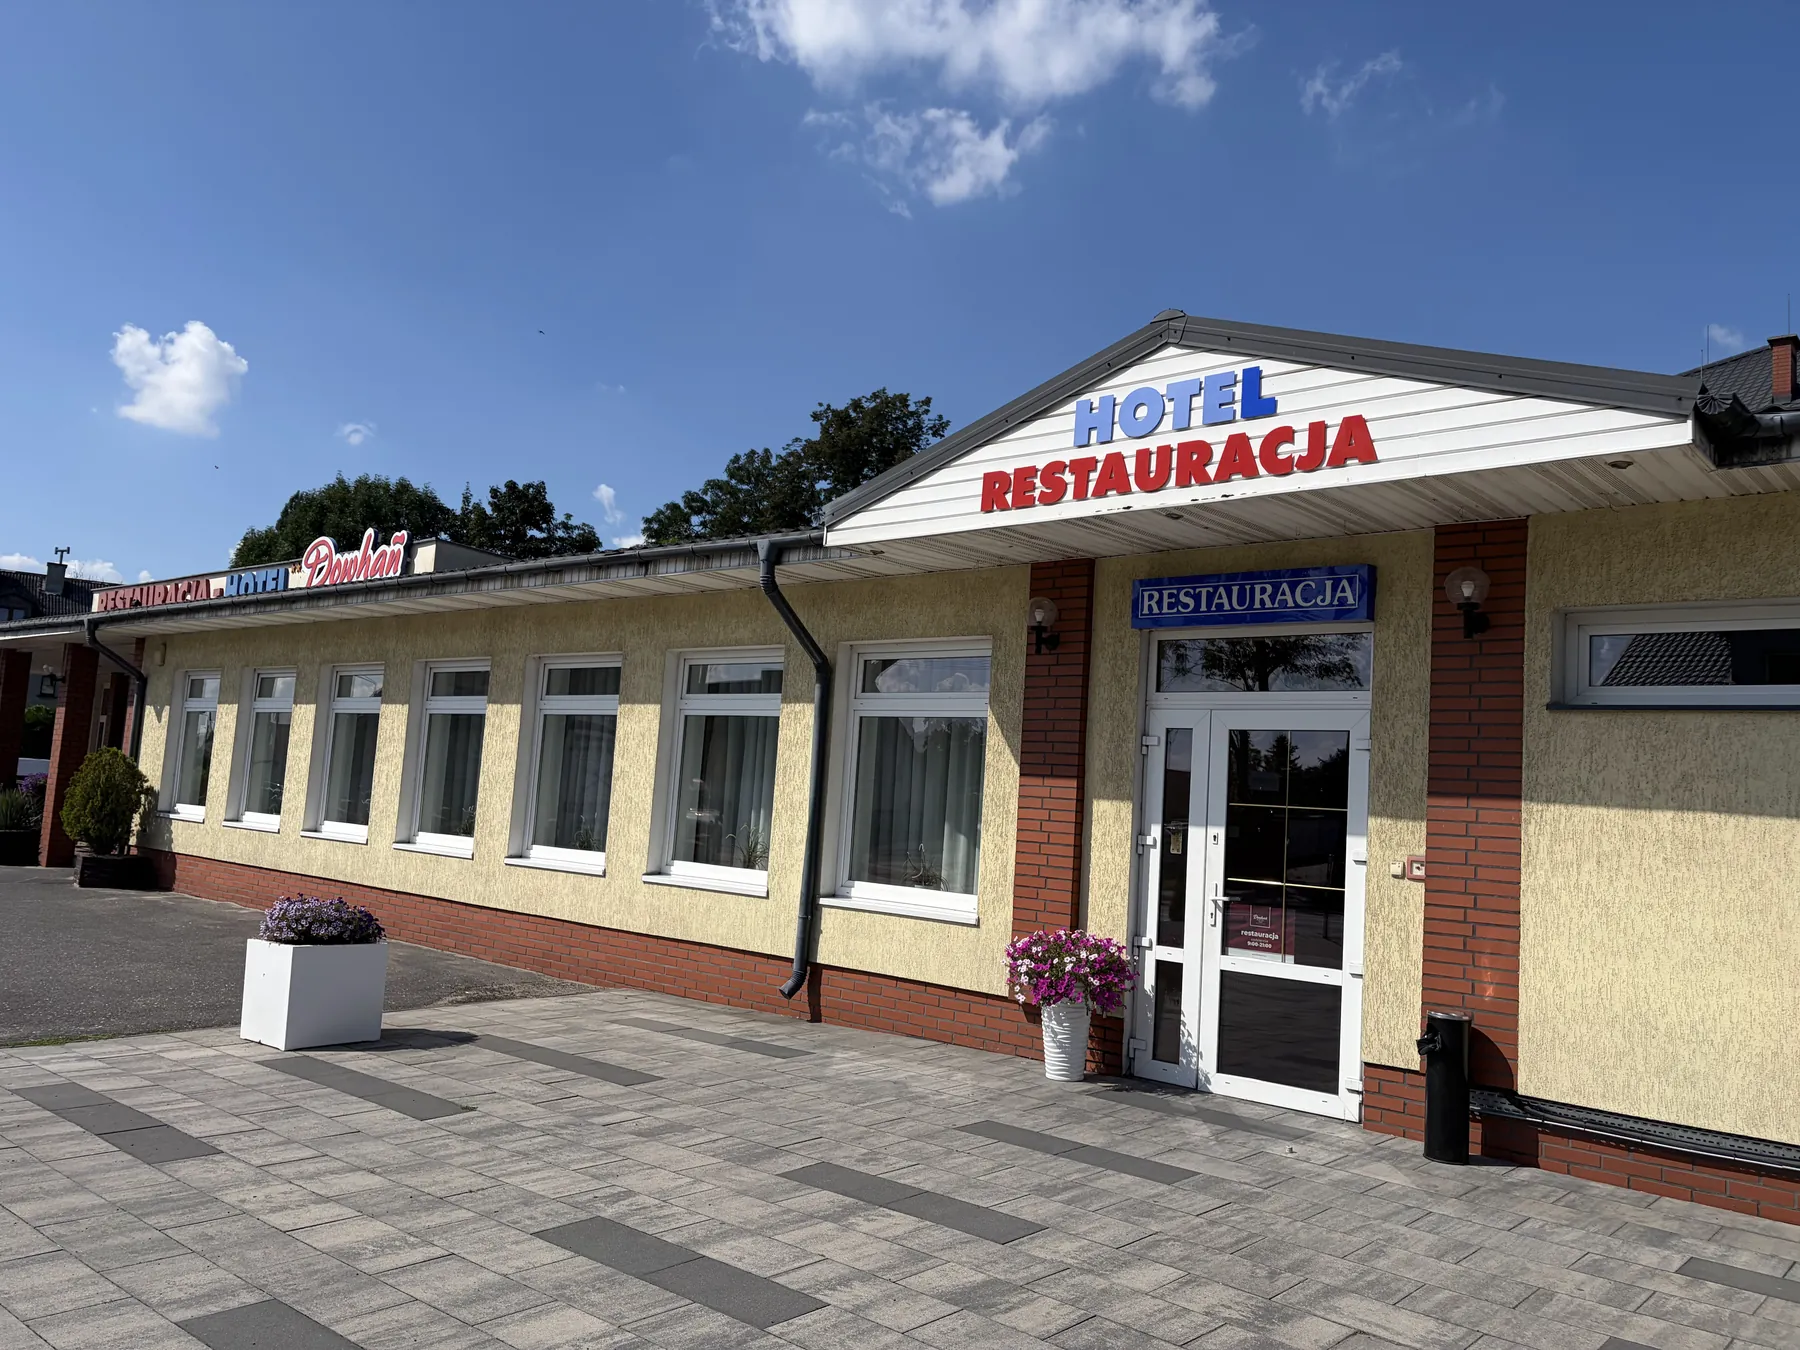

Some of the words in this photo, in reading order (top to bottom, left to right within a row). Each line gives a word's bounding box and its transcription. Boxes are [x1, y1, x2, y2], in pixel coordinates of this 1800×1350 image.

[1073, 366, 1277, 447] HOTEL
[981, 414, 1378, 512] RESTAURACJA
[1142, 579, 1355, 614] RESTAURACJA
[1240, 930, 1279, 940] restauracja
